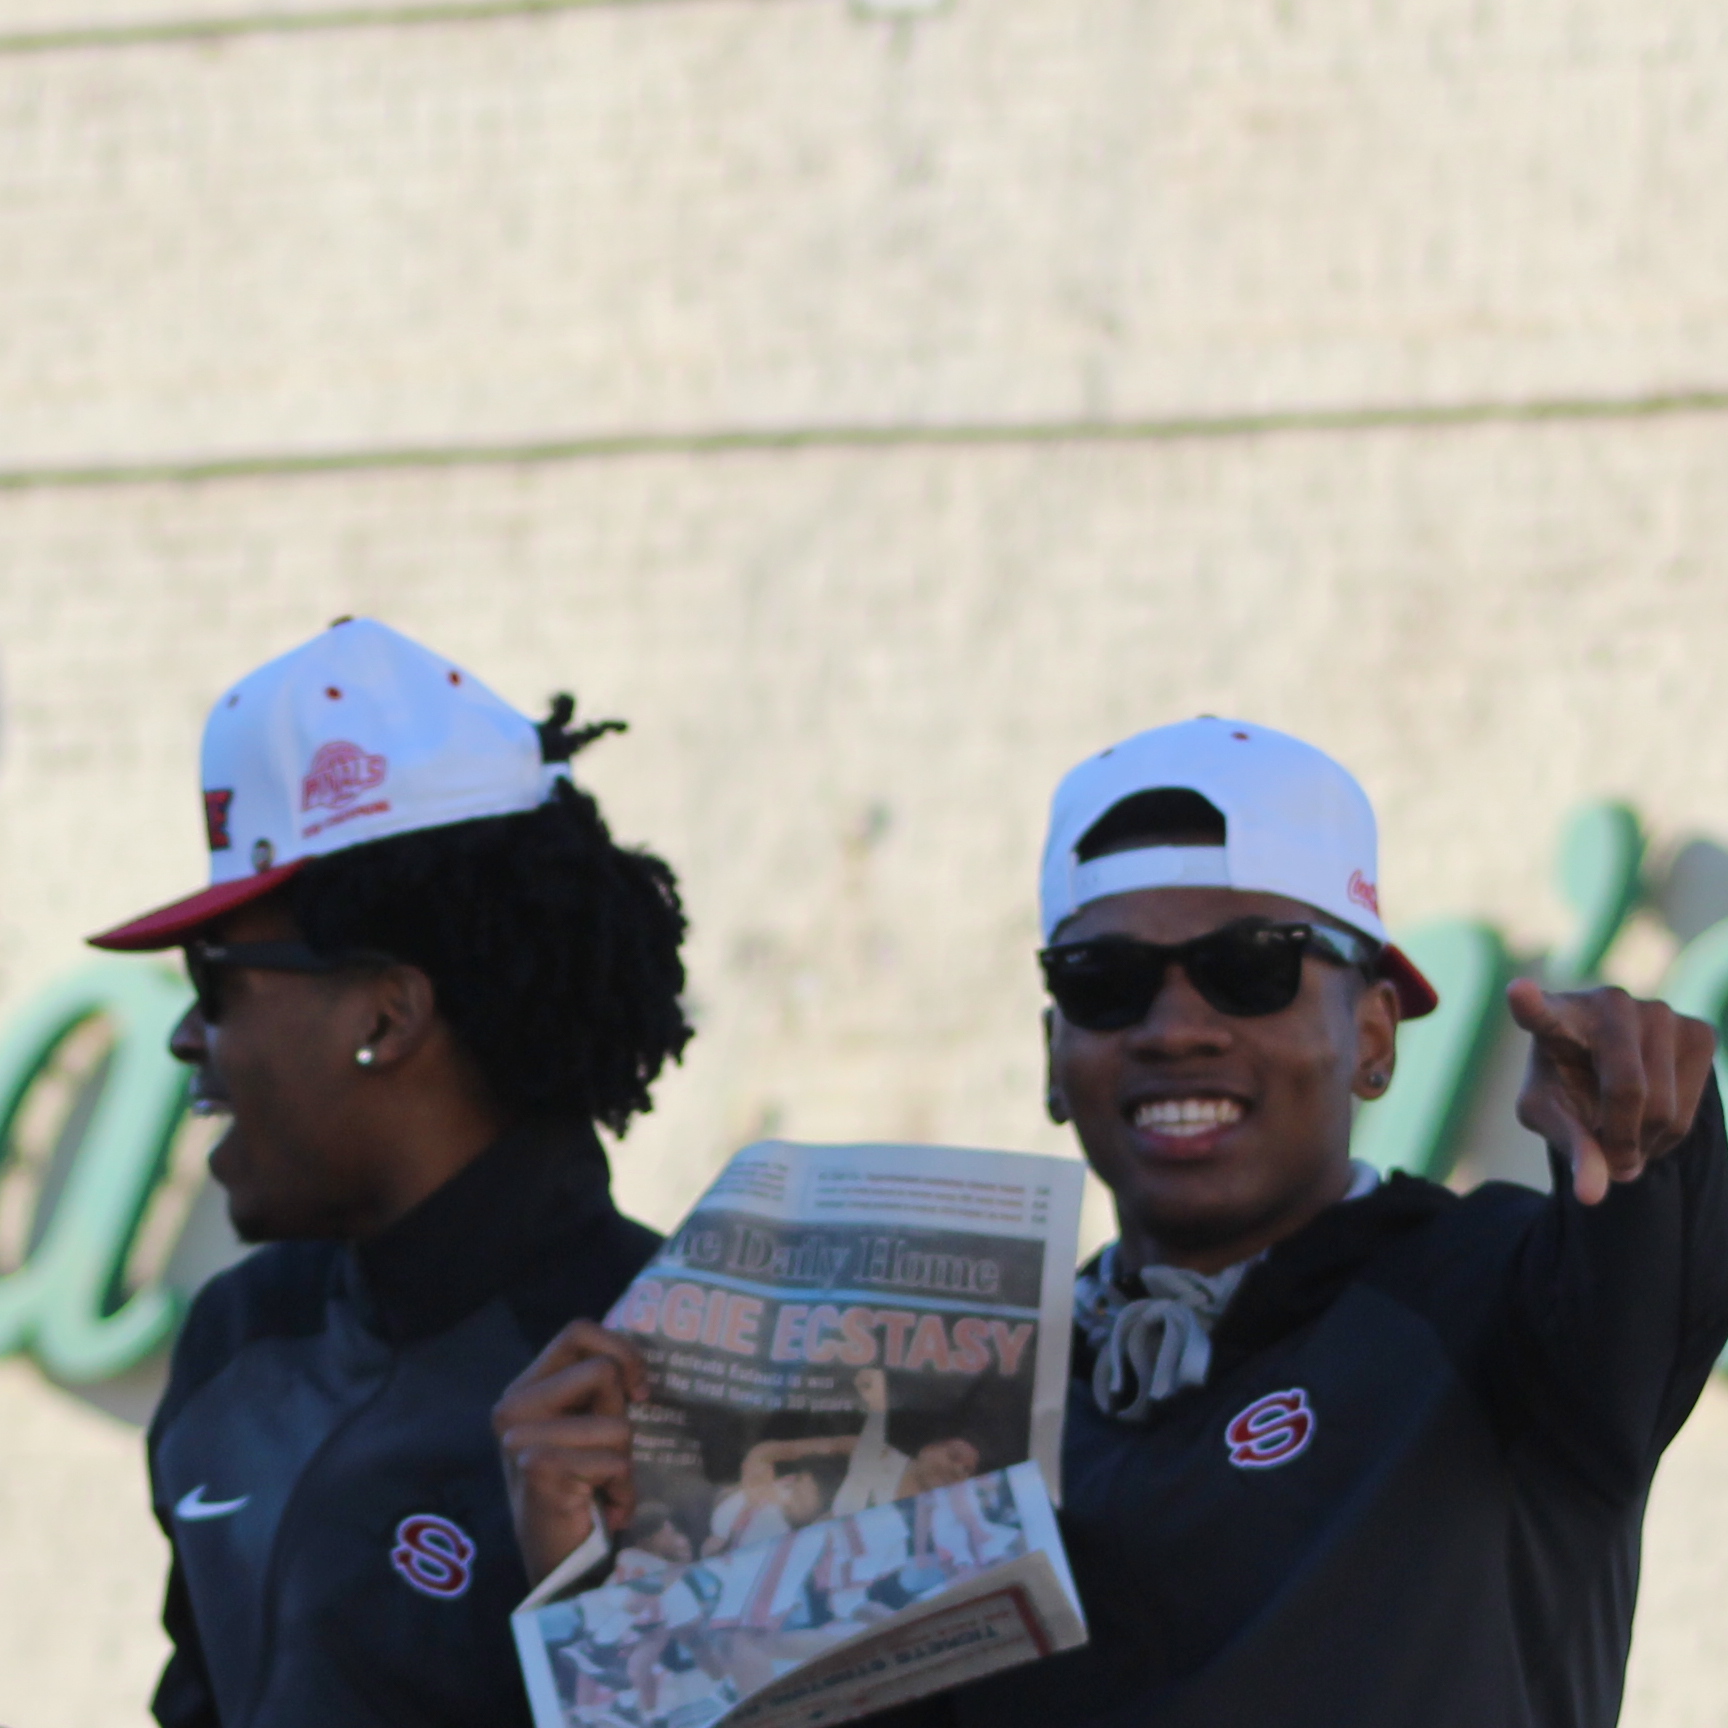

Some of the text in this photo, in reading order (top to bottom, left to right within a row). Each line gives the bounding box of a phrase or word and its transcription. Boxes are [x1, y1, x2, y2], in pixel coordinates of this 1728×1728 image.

[728, 1223, 850, 1289] Daily
[855, 1235, 1001, 1296] Home
[604, 1280, 1035, 1377] GGIE ECSTASY
[1225, 1387, 1316, 1468] S
[390, 1514, 477, 1599] S
